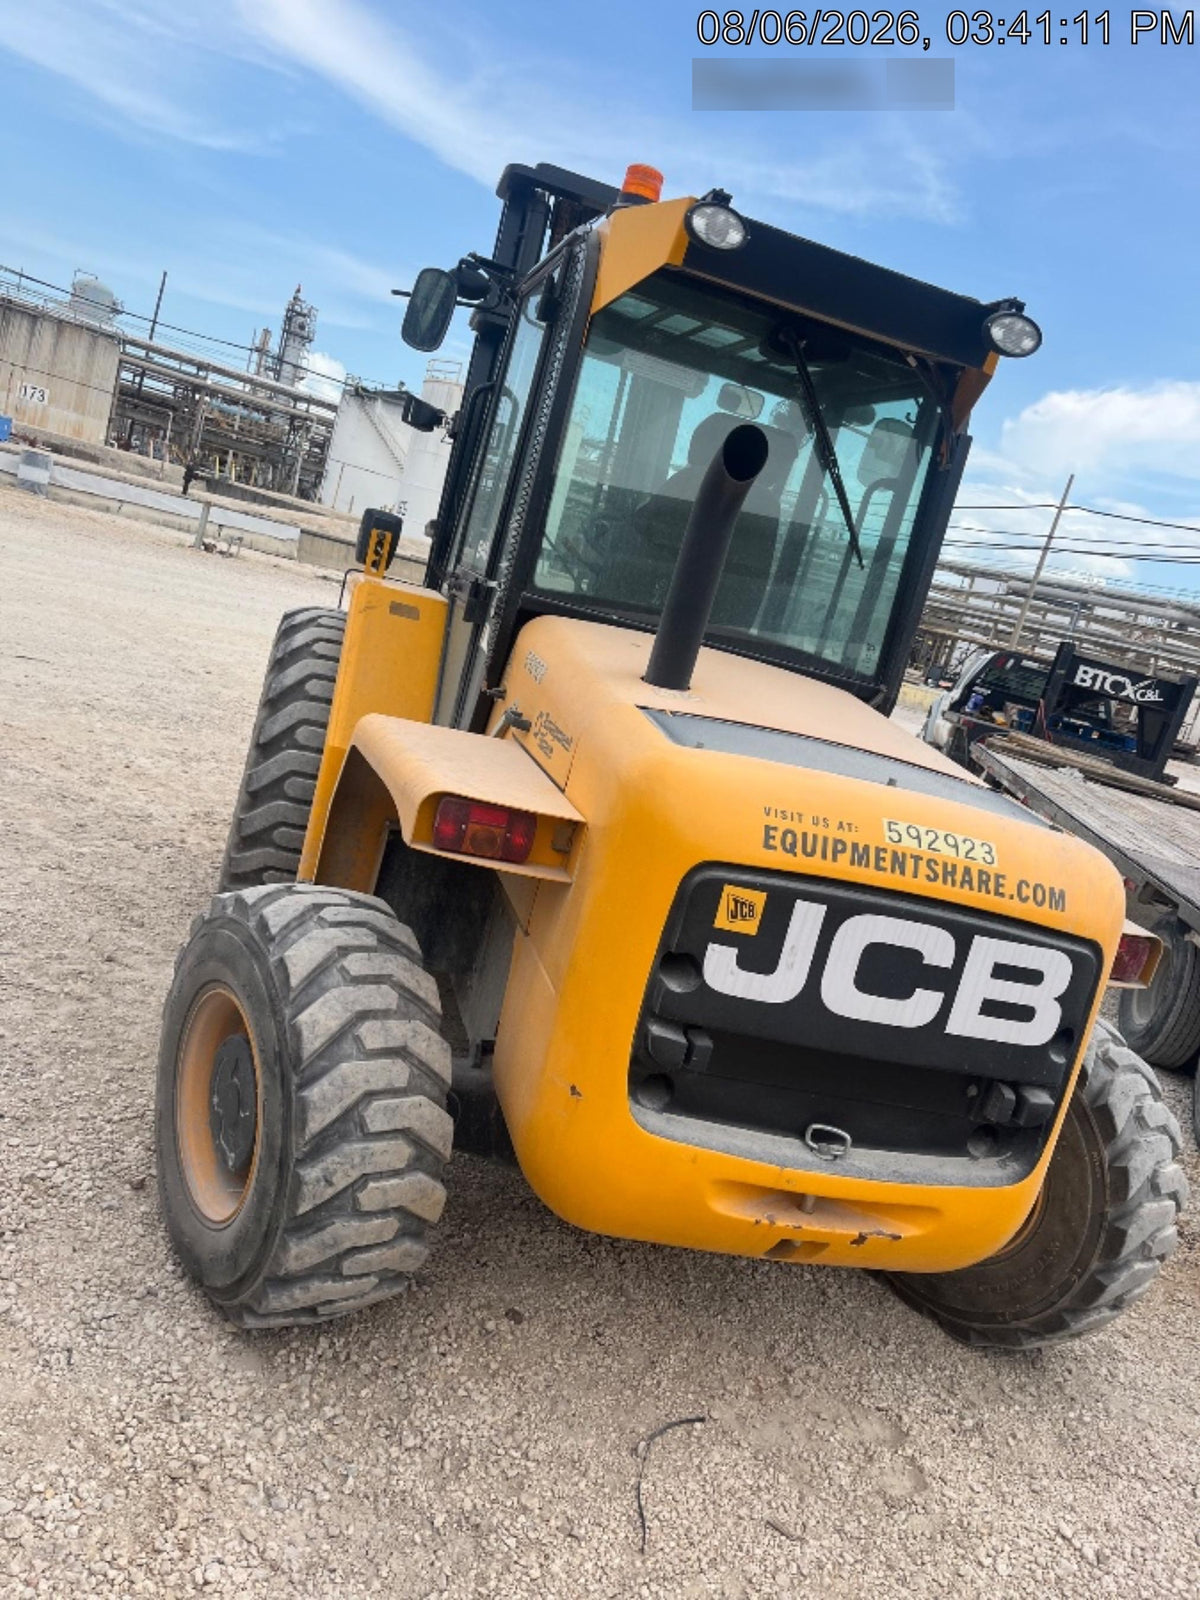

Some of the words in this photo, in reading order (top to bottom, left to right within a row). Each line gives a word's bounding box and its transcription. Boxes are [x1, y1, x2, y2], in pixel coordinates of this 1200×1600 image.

[23, 385, 45, 402] 173
[764, 806, 803, 823] VISIT
[812, 816, 829, 829] US
[837, 821, 859, 832] AT:
[886, 821, 995, 865] 592923
[762, 824, 1066, 912] EQUIPMENTSHARE.COM
[730, 897, 755, 920] JCB
[703, 899, 1073, 1047] JCB
